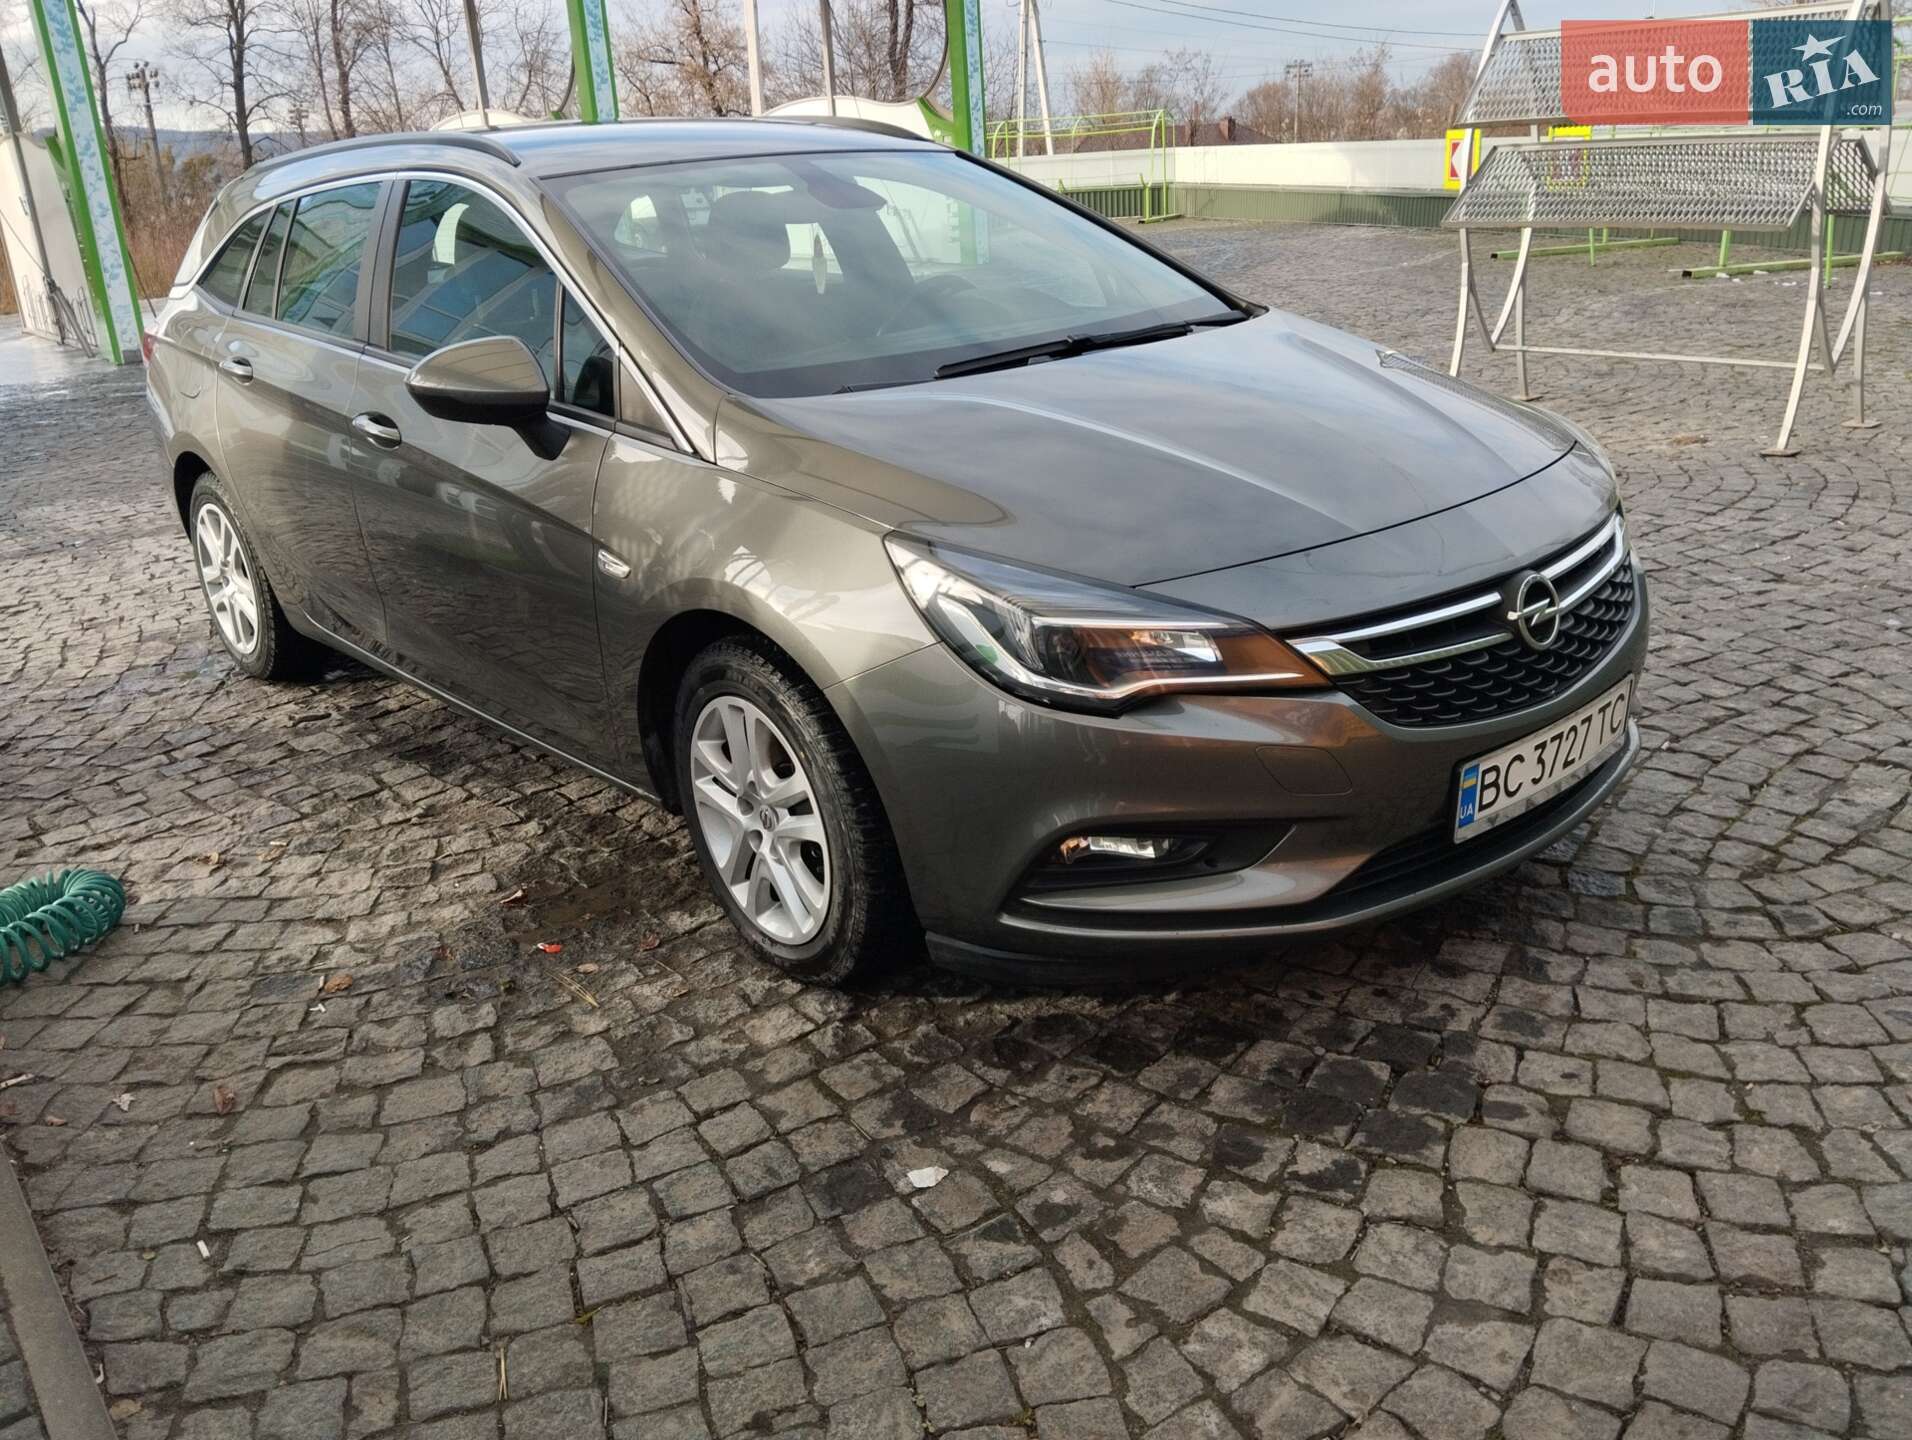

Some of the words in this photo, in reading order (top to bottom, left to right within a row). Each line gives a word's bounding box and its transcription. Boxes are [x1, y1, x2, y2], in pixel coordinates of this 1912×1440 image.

[1478, 753, 1525, 813] BC
[1531, 714, 1593, 785] 3727
[1598, 693, 1625, 745] TC
[1460, 805, 1474, 819] UA
